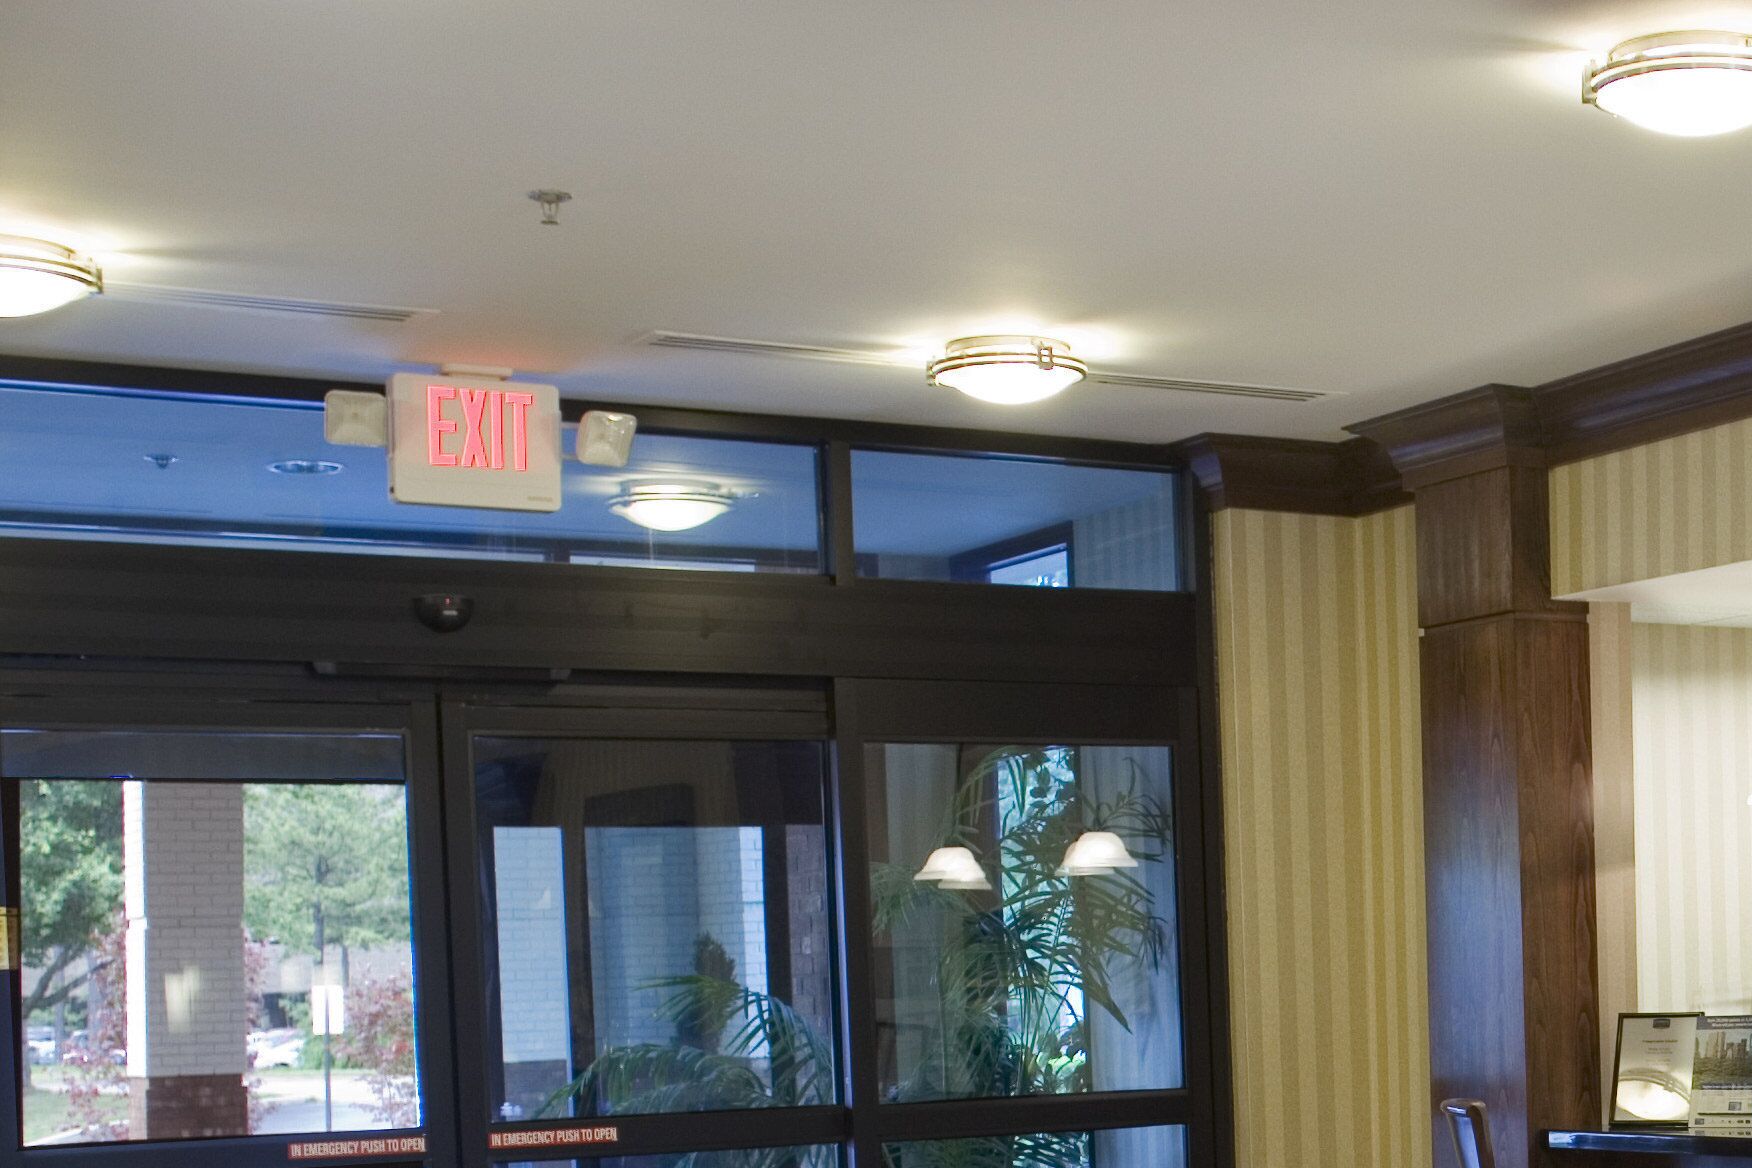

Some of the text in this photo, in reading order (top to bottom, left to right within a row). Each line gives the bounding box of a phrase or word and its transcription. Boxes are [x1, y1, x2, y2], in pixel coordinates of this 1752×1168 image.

[426, 384, 533, 471] EXIT
[291, 1137, 425, 1157] IN EMERGENCY PUSH TO OPEN
[491, 1127, 617, 1147] IN EMERGENCY PUSH TO OPEN
